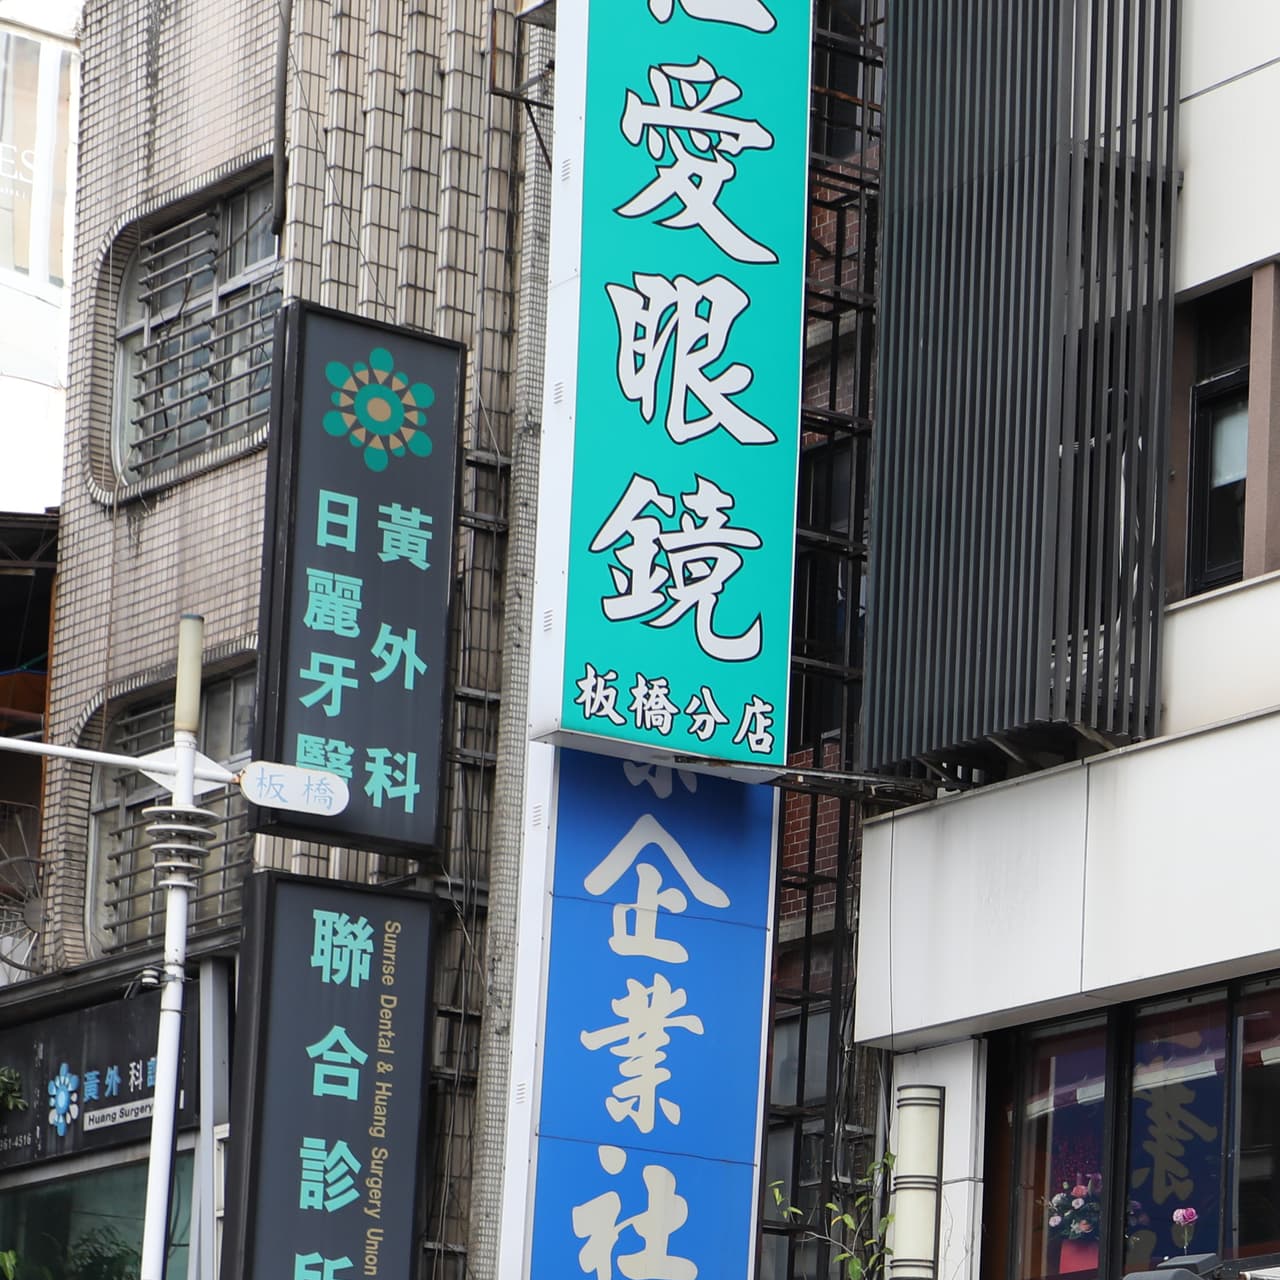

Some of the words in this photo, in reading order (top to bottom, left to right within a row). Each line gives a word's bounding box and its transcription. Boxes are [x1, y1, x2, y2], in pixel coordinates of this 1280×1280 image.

[369, 502, 434, 814] 黃外科
[573, 662, 777, 757] 板橋分店
[256, 766, 336, 811] 板橋
[381, 920, 402, 986] Sunrise
[377, 993, 398, 1054] Dental
[376, 1060, 394, 1075] &
[88, 1109, 117, 1126] Huang
[369, 1080, 394, 1139] Huang
[364, 1147, 389, 1219] Surgery
[363, 1227, 384, 1277] Union
